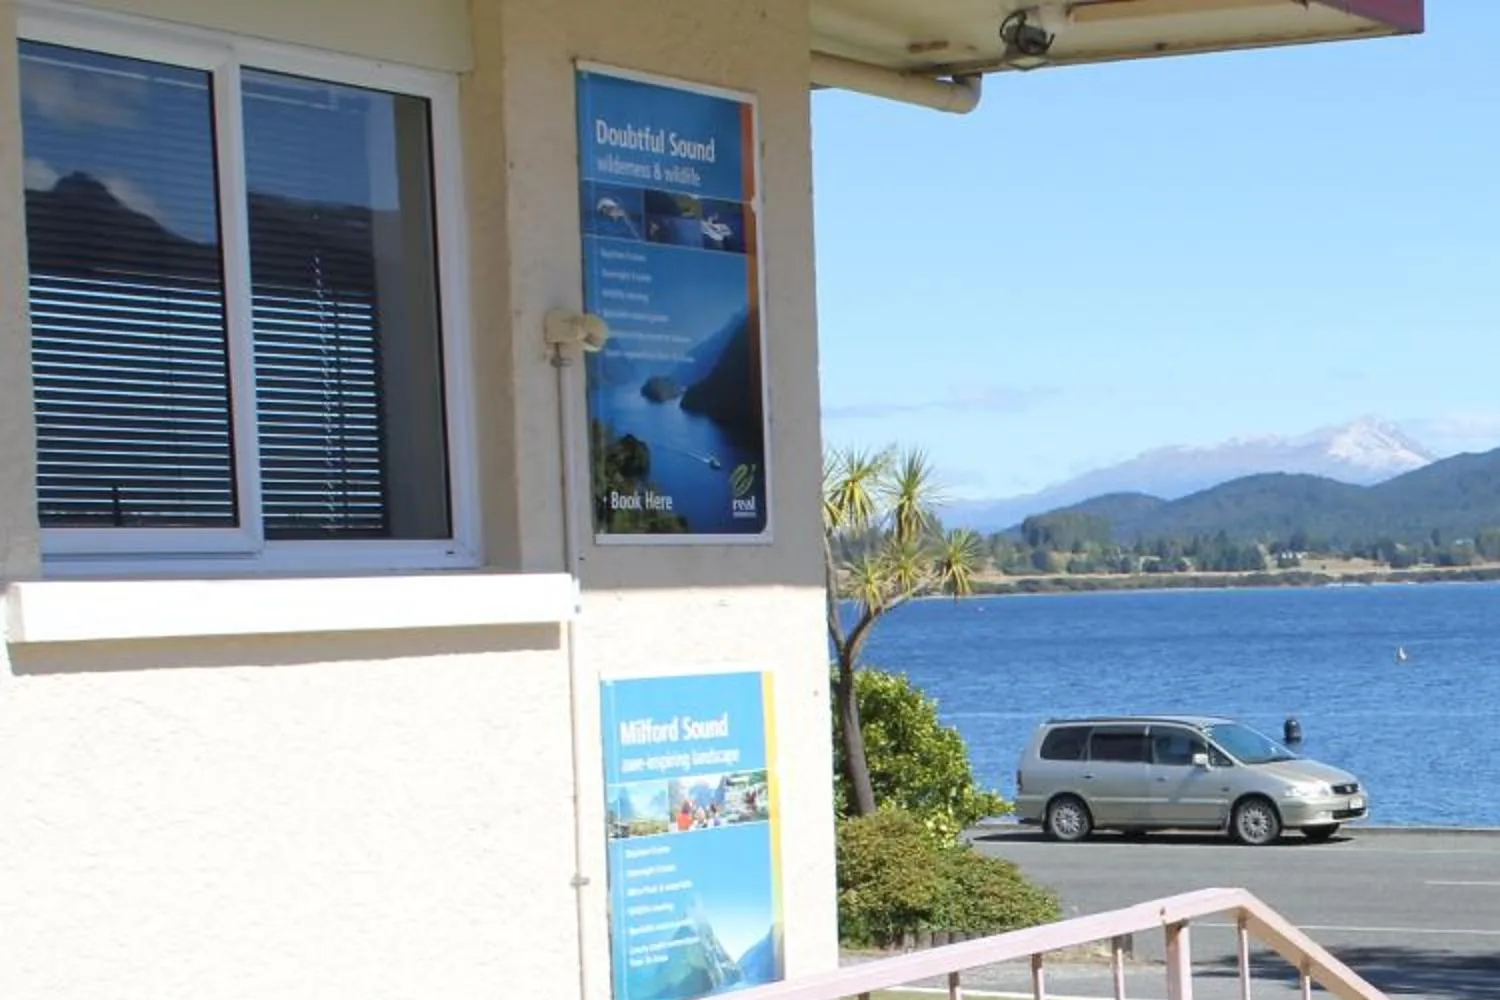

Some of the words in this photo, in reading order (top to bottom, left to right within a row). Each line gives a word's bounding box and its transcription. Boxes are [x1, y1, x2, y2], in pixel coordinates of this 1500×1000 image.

[596, 120, 664, 154] Doubtful
[669, 132, 716, 163] Sound
[611, 491, 642, 510] Book
[645, 491, 673, 511] Here
[732, 495, 756, 511] real
[620, 716, 679, 745] Milford
[683, 711, 729, 740] Sound
